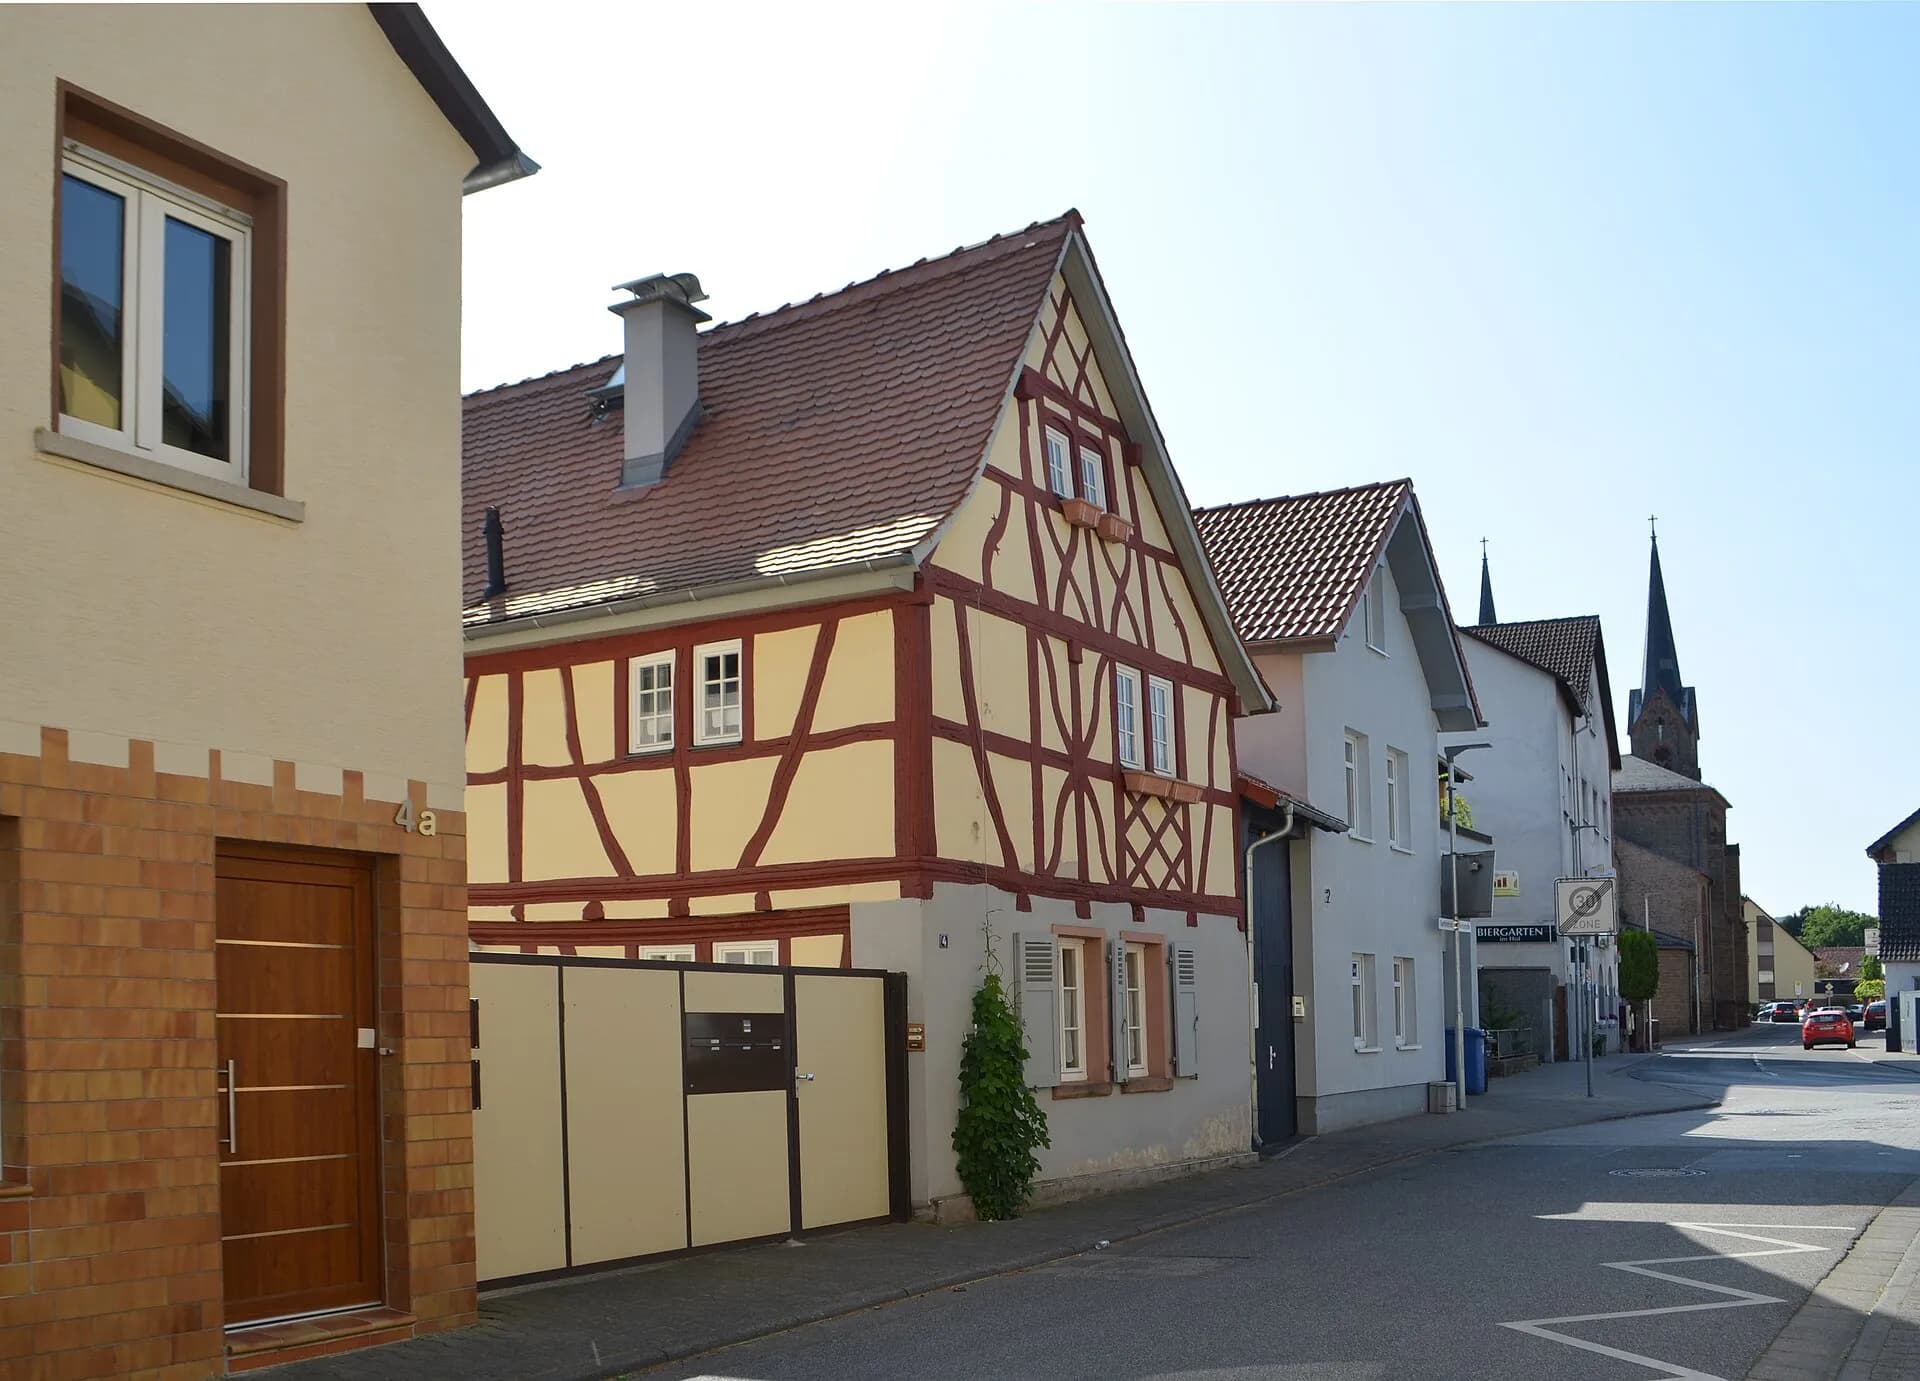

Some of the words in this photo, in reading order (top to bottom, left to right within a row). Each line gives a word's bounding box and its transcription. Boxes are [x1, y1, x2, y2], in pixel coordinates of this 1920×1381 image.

[395, 800, 436, 836] 4a
[1575, 894, 1595, 908] 30
[1477, 927, 1543, 937] BIERGARTEN
